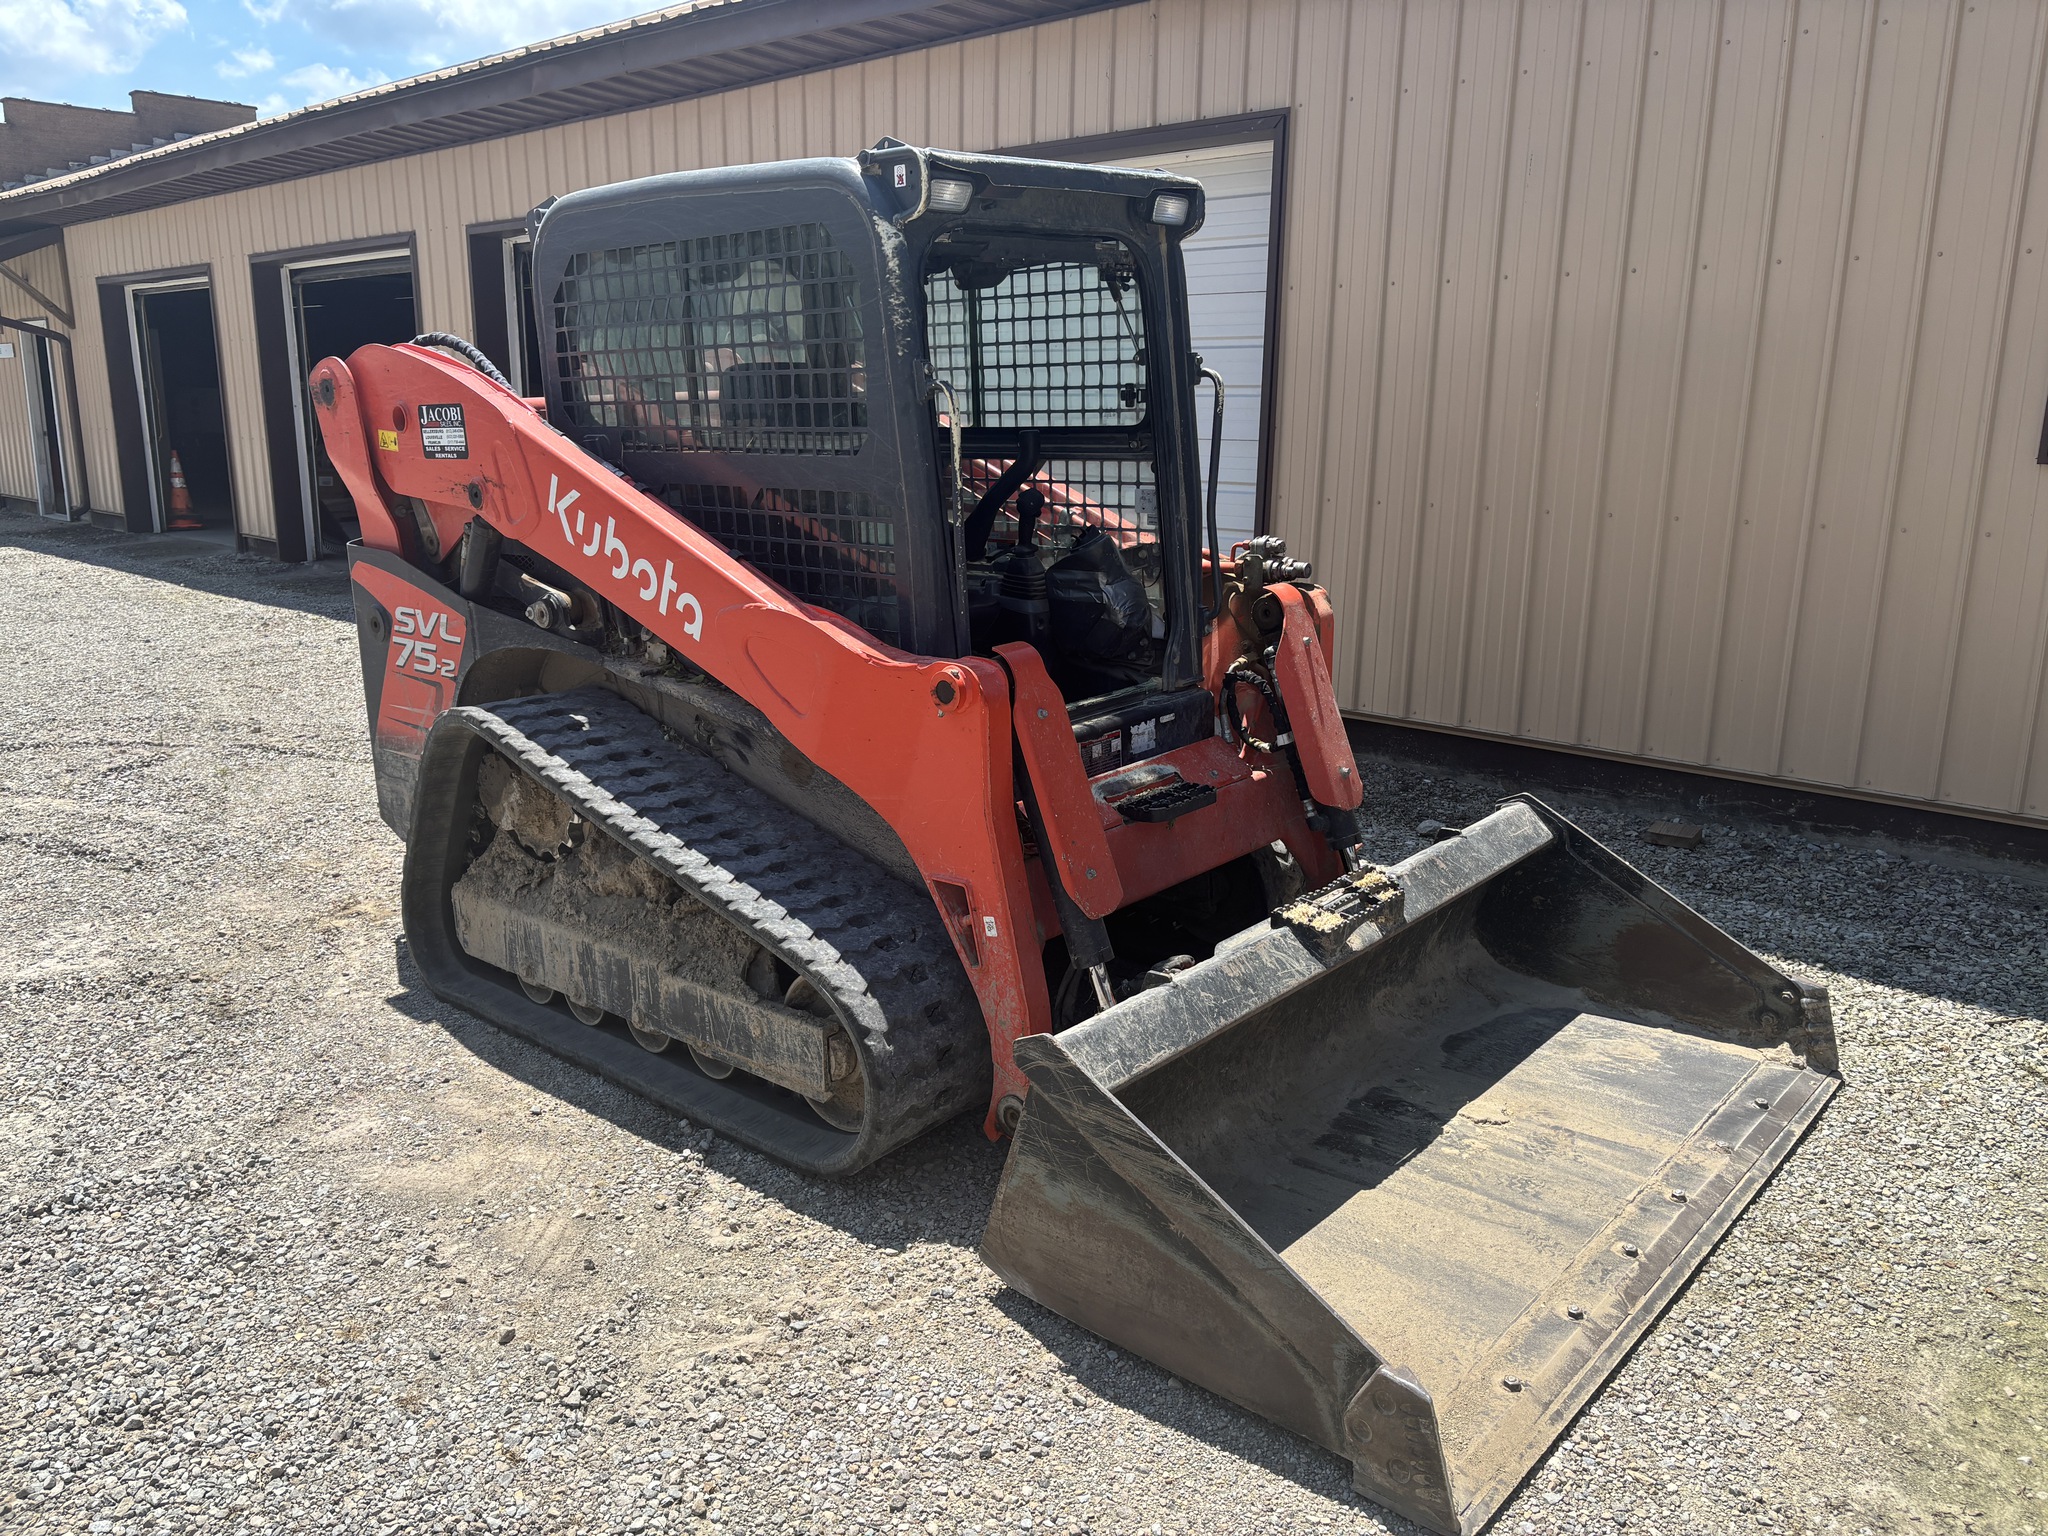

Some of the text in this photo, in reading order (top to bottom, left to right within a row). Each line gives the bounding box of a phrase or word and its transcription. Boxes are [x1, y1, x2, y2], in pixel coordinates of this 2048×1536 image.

[421, 406, 461, 425] JACOBI
[548, 473, 703, 642] Kubota
[393, 606, 461, 643] SVL
